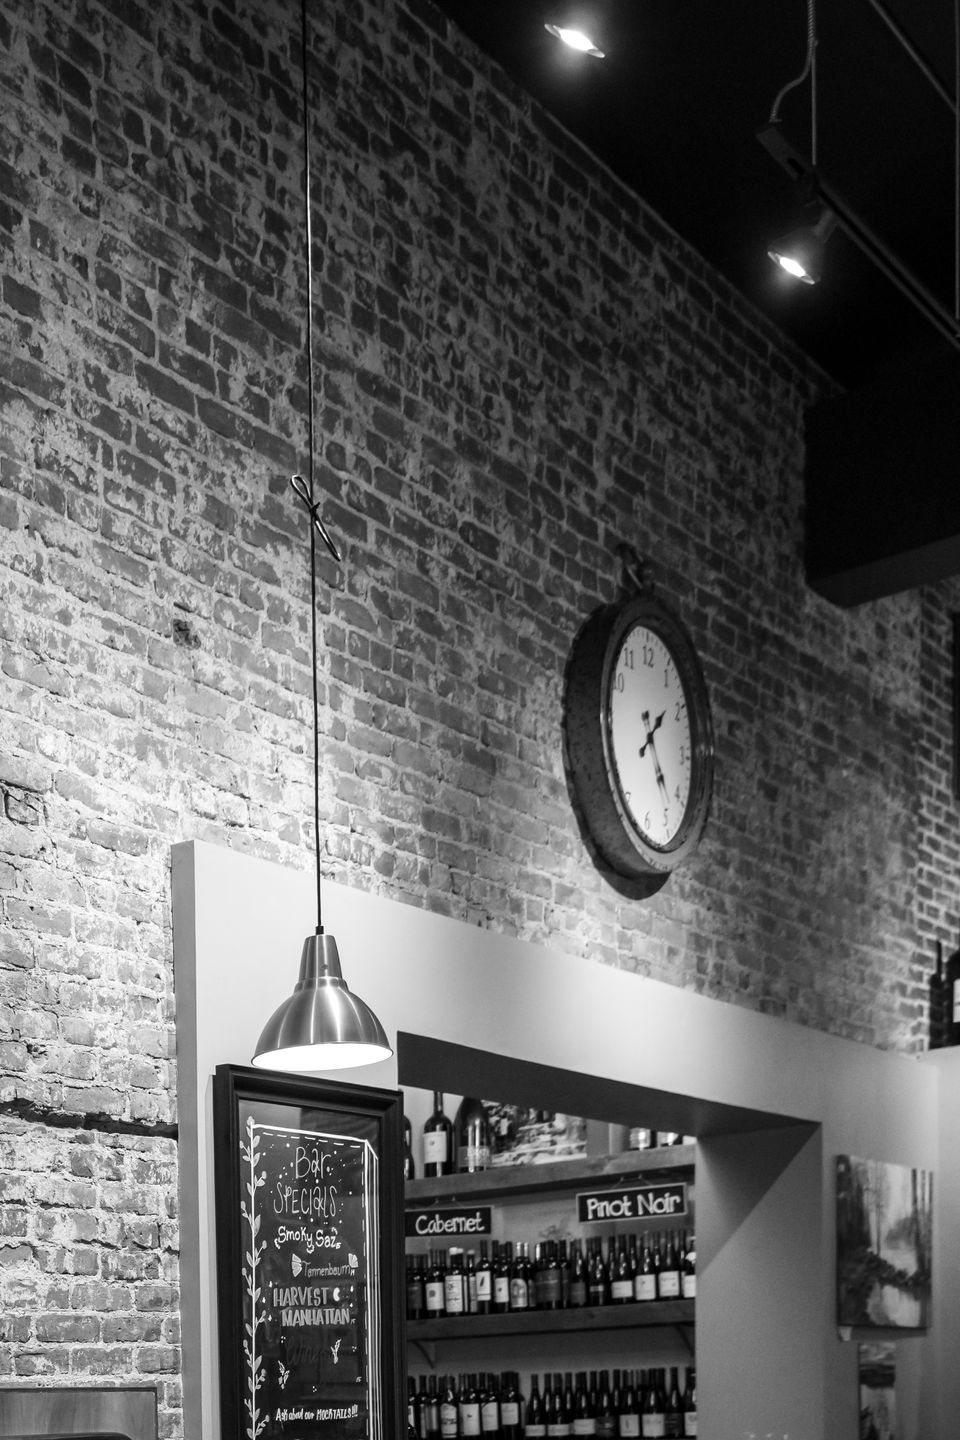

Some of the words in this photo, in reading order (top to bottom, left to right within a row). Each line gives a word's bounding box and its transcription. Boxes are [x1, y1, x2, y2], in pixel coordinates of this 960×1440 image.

[643, 645, 654, 668] 12
[674, 701, 681, 722] 2
[644, 810, 651, 831] 6
[295, 1146, 332, 1179] Bar
[586, 1195, 633, 1220] Pinot
[637, 1192, 681, 1216] Noir
[415, 1211, 486, 1235] Cabernet
[315, 1228, 337, 1248] Saz
[273, 1286, 330, 1307] HARVEST
[281, 1308, 350, 1327] MANHATTAN
[276, 1407, 288, 1421] Ask
[288, 1407, 304, 1421] about
